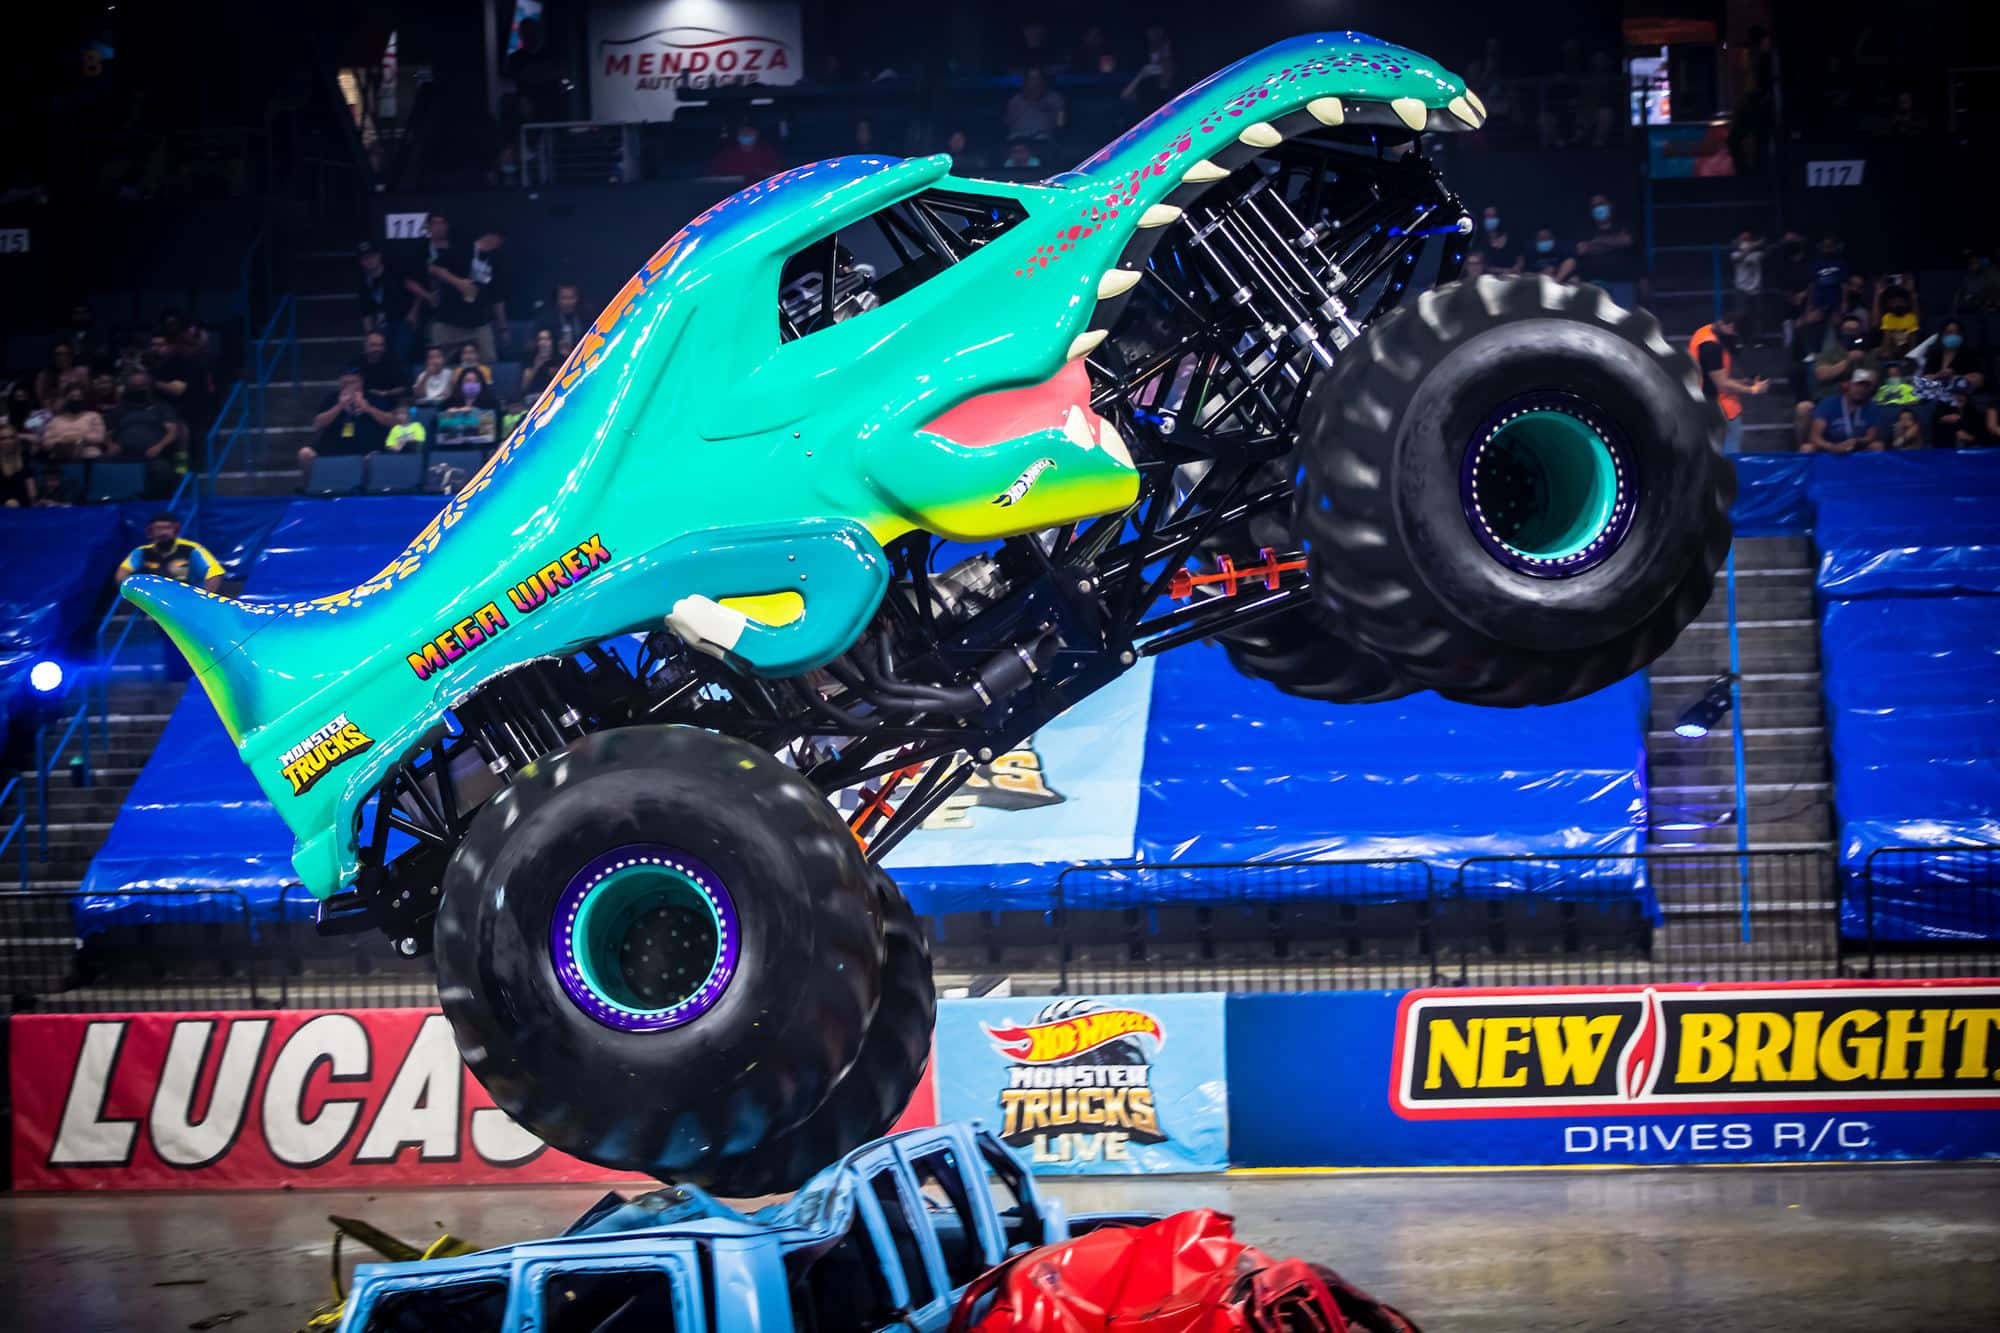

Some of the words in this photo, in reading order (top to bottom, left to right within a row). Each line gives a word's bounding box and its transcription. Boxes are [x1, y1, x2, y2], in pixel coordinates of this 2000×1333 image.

[604, 49, 788, 76] MENDOZA
[1814, 166, 1854, 186] 117
[406, 601, 510, 681] MEGA
[506, 533, 612, 614] WREX
[277, 711, 349, 766] MONSTER
[281, 722, 376, 796] TRUCKS
[1025, 1022, 1079, 1062] HOT
[1075, 1010, 1156, 1050] WHEELS
[1423, 1014, 1623, 1090] NEW
[1004, 1064, 1152, 1089] MONSTER
[999, 1086, 1166, 1140] TRUCKS
[1565, 1122, 1753, 1153] DRIVES
[1774, 1117, 1871, 1151] R/C
[1031, 1131, 1131, 1163] LIVE
